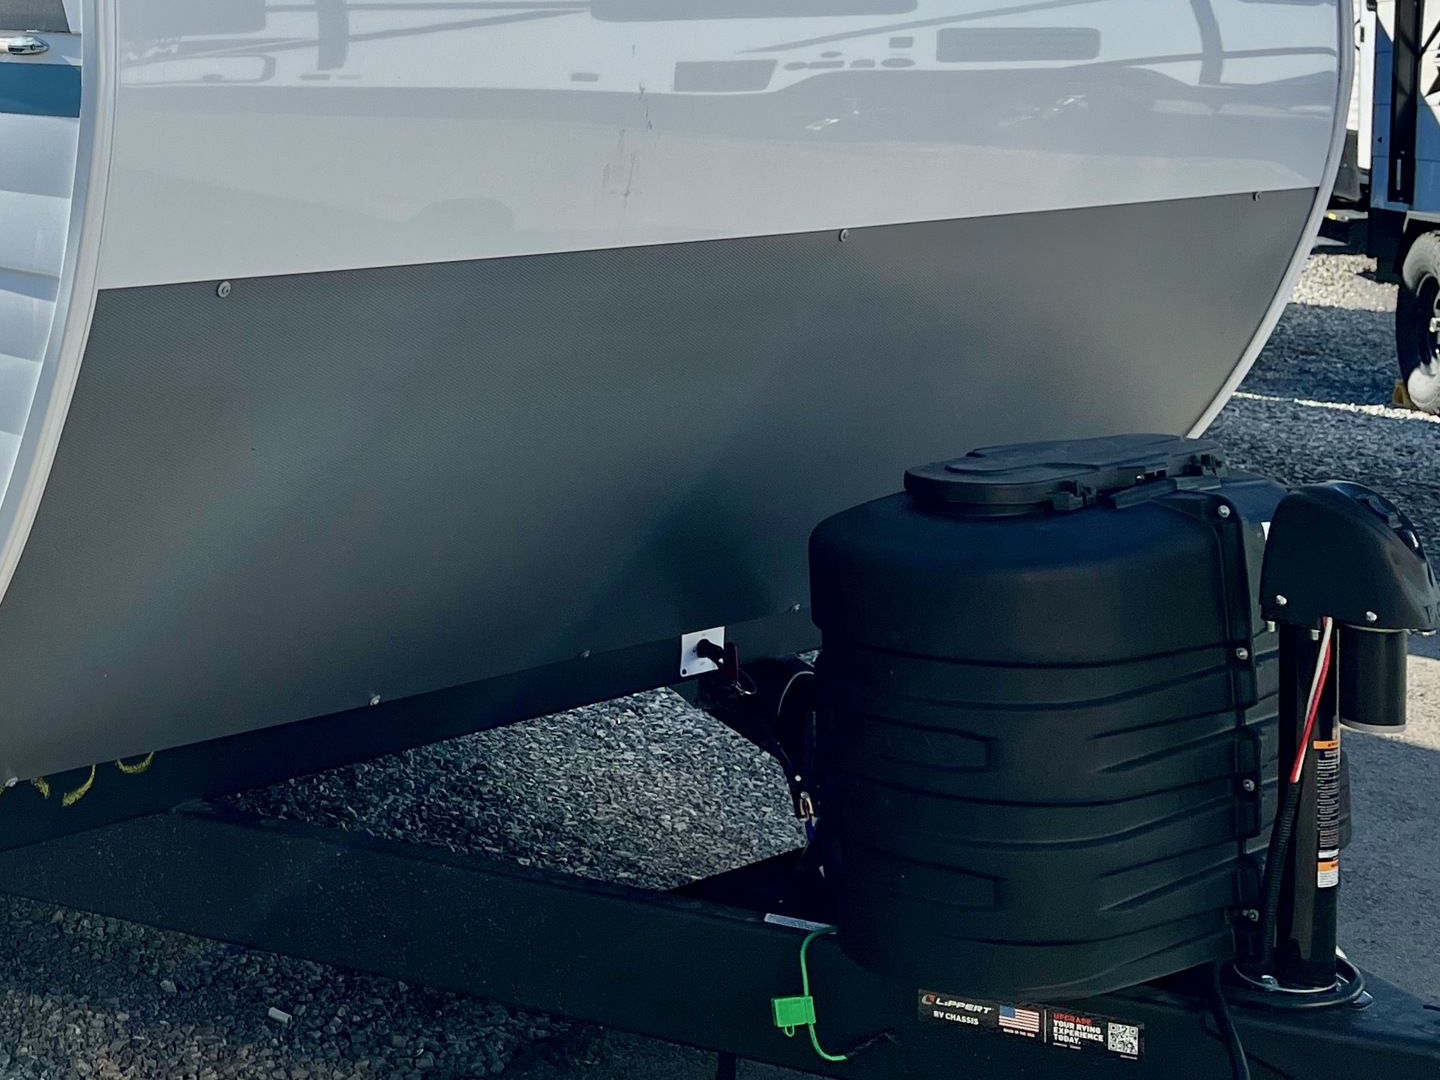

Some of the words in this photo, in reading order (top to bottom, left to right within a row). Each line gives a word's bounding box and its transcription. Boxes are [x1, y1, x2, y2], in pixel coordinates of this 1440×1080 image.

[935, 997, 992, 1015] LIPPERT
[933, 1010, 945, 1019] RV
[945, 1012, 979, 1026] CHASSIS
[1053, 1019, 1075, 1030] YOUR
[1053, 1026, 1104, 1043] EXPERIENCE
